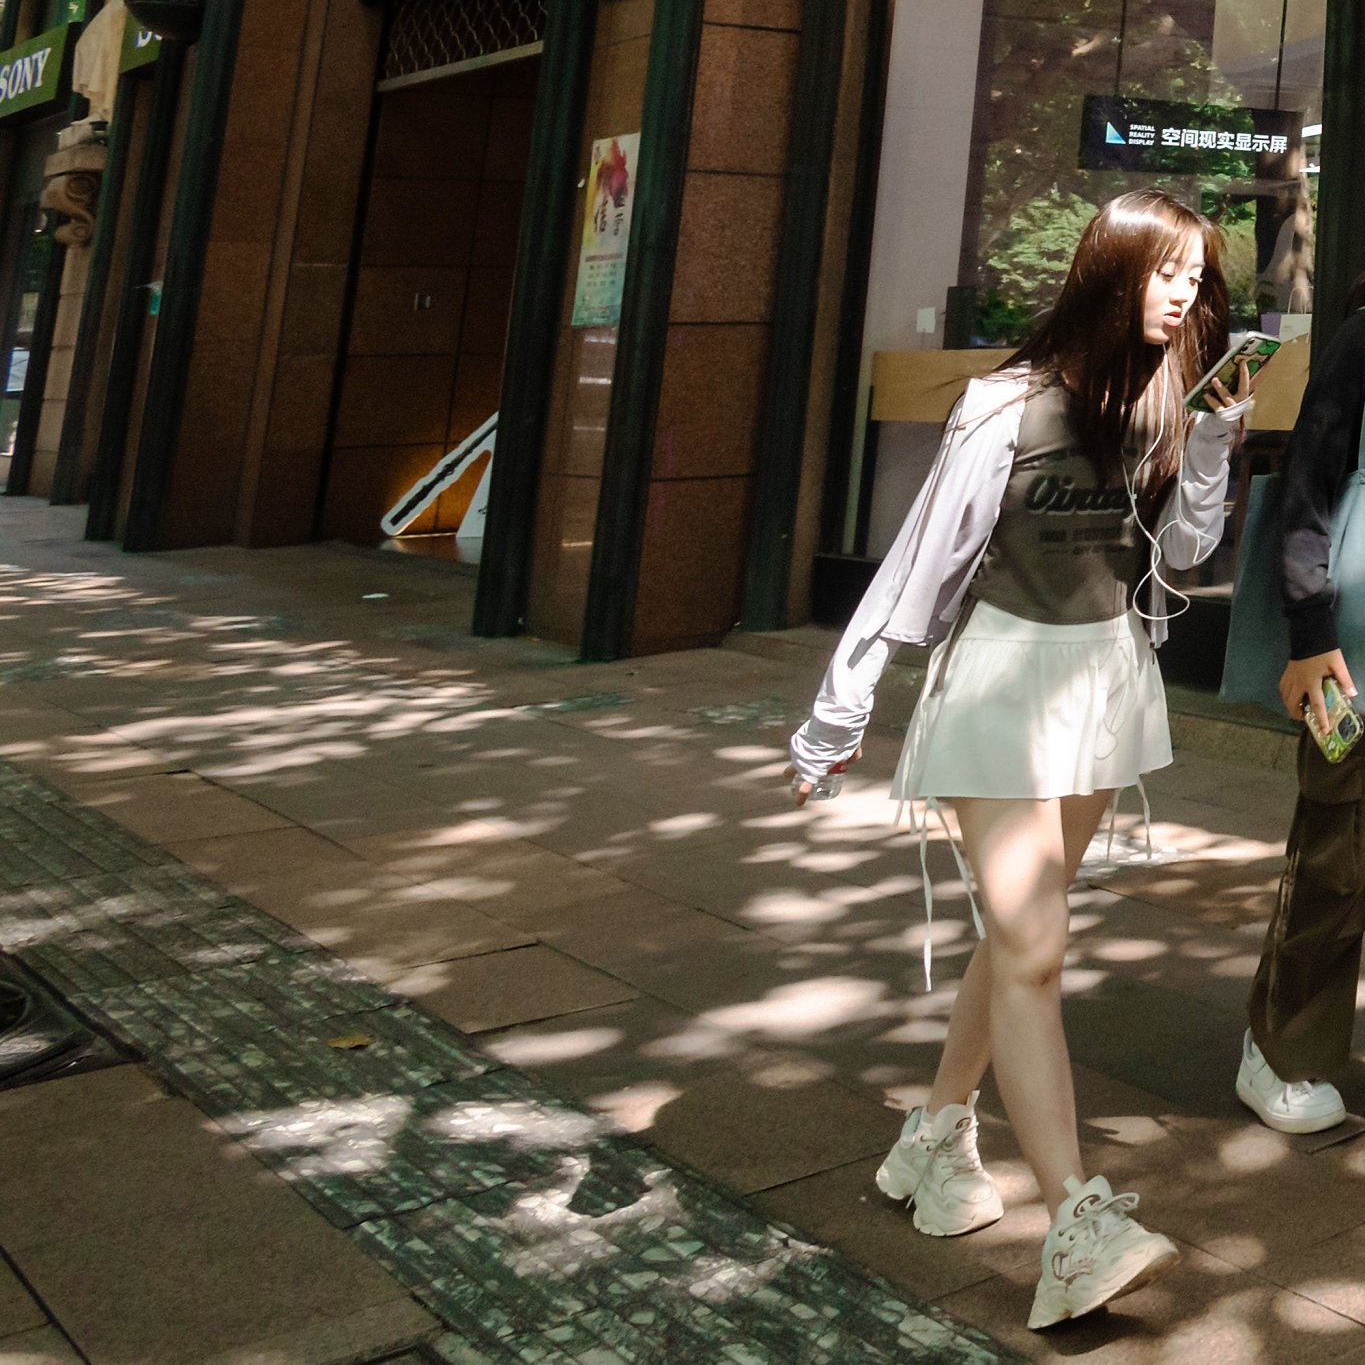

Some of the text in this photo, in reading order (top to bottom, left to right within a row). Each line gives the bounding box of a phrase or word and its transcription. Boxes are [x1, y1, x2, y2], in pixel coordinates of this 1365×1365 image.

[1130, 123, 1155, 132] SPATIAL
[1129, 131, 1156, 139] REALITY
[1128, 138, 1155, 146] DISPLAY
[1161, 127, 1288, 154] 空间现实显示屏
